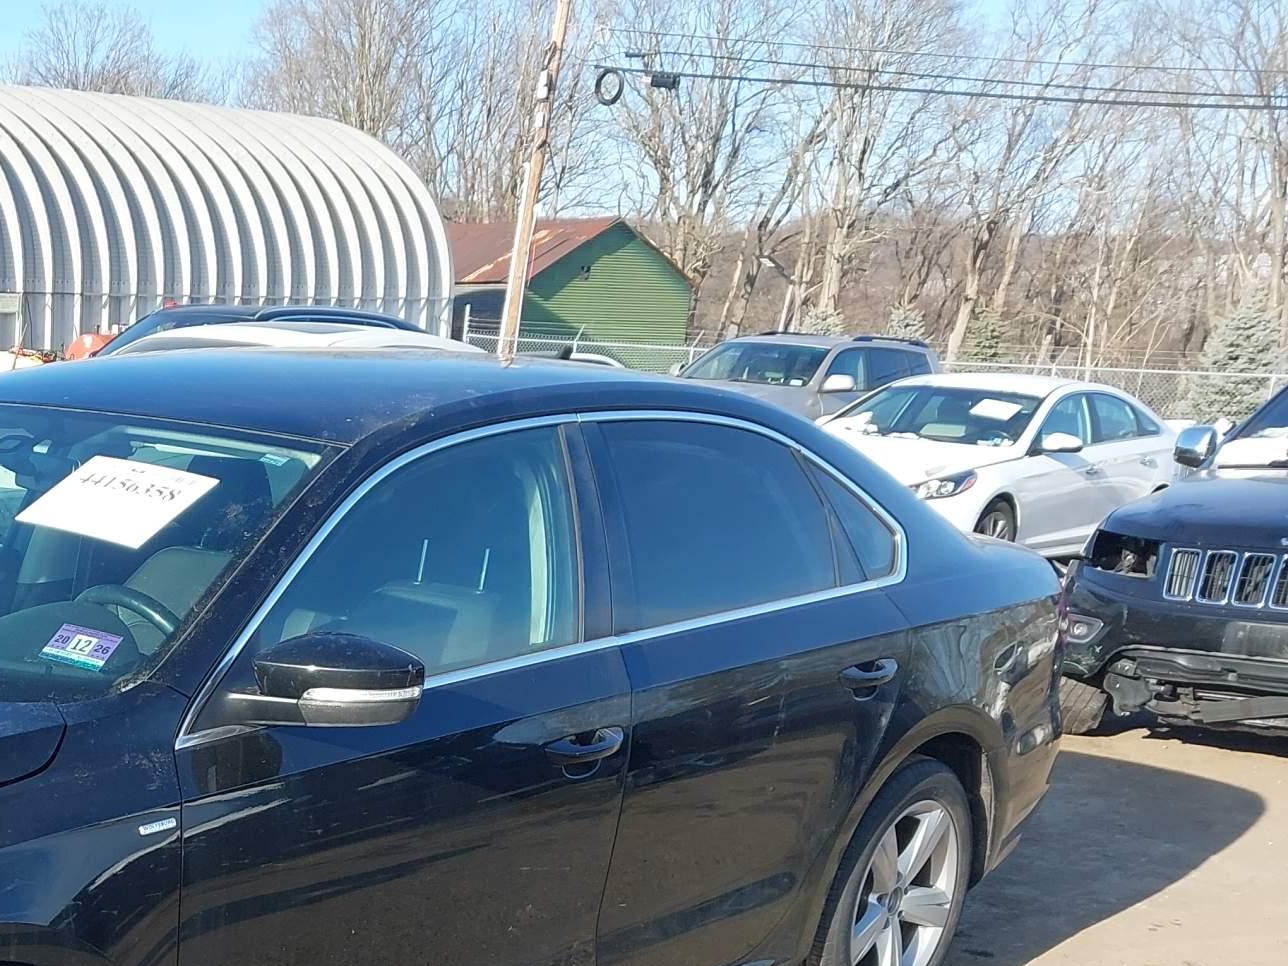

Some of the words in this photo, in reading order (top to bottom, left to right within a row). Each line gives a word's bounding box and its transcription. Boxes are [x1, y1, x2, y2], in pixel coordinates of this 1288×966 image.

[54, 634, 71, 645] 20
[70, 638, 93, 652] 12
[93, 644, 111, 655] 26
